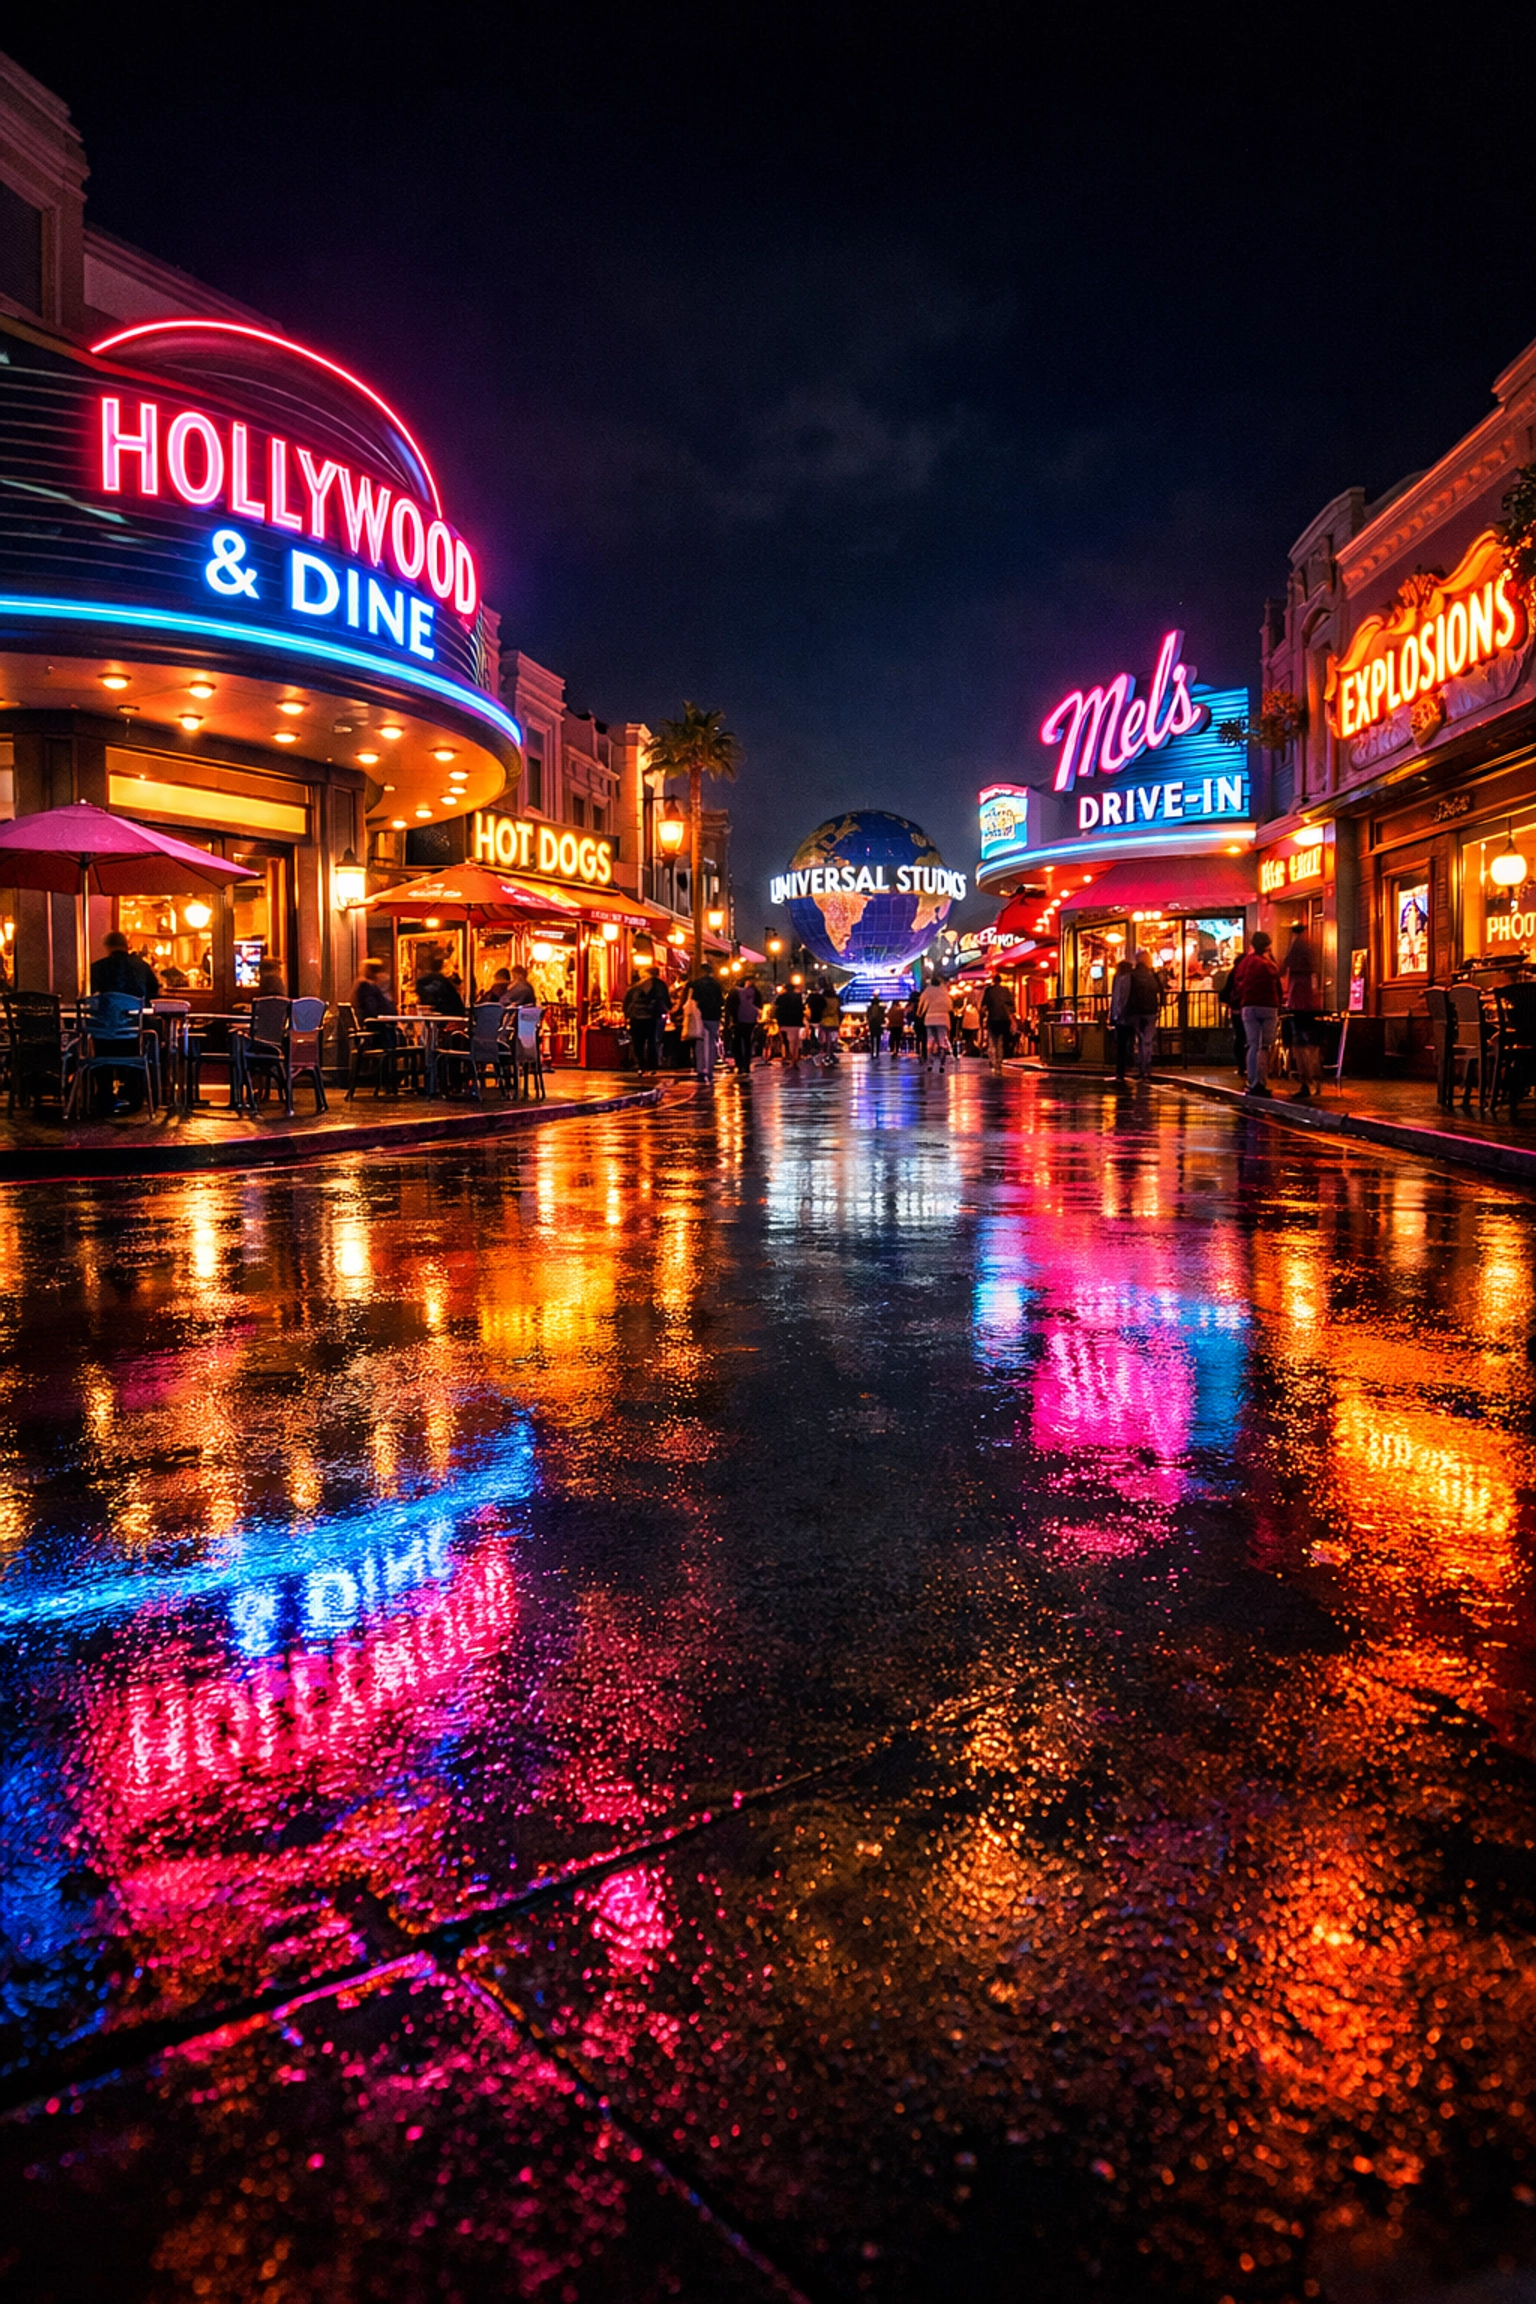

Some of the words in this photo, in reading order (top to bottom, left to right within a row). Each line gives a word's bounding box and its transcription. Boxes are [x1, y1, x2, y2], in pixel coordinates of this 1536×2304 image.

[102, 397, 477, 615] HOLLYWOOD
[205, 529, 260, 600] &
[291, 550, 436, 661] DINE
[1342, 568, 1515, 738] EXPLOSIONS
[474, 810, 535, 867] HOT
[538, 825, 613, 886] DOGS
[1078, 775, 1243, 829] DRIVE-IN
[769, 865, 890, 905] UNIVERSAL
